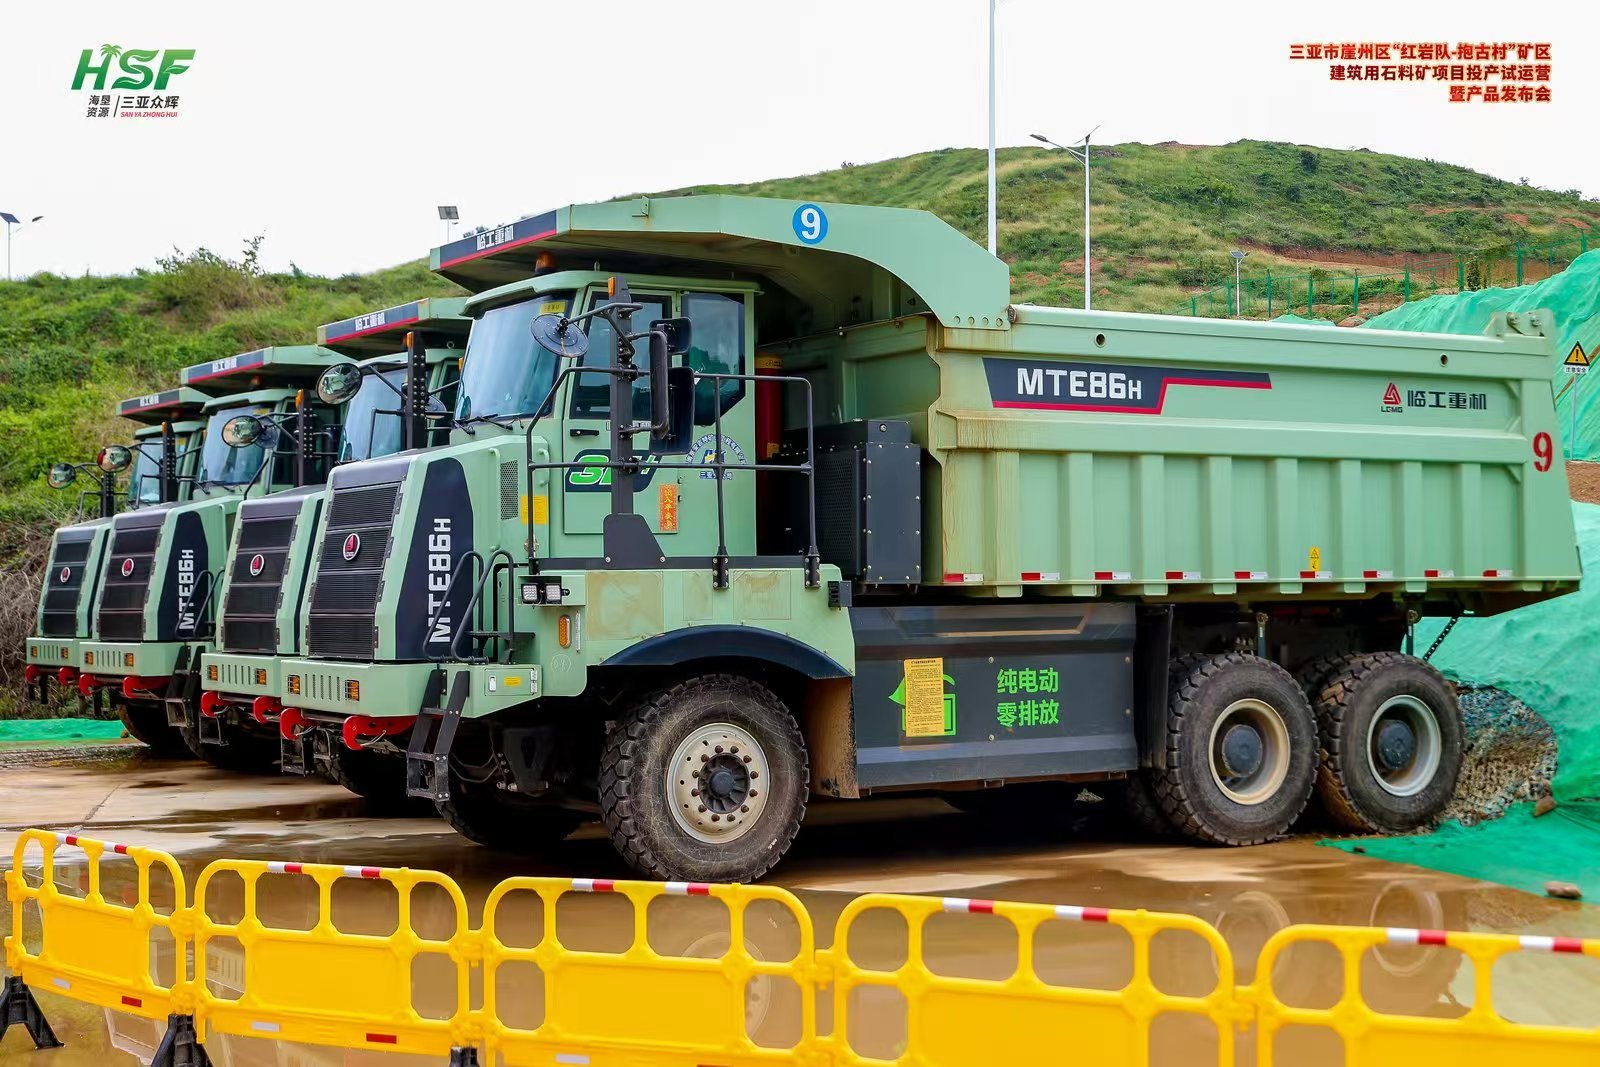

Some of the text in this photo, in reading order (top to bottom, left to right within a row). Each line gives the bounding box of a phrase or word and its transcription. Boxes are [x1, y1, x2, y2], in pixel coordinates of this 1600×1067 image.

[801, 207, 821, 240] 9
[1017, 367, 1142, 400] MTE86H
[1407, 390, 1487, 410] 临工重机
[1532, 431, 1553, 473] 9
[178, 549, 194, 630] MTE86H
[428, 518, 451, 643] MTE86H
[997, 667, 1059, 694] 纯电动
[997, 699, 1060, 727] 零排放
